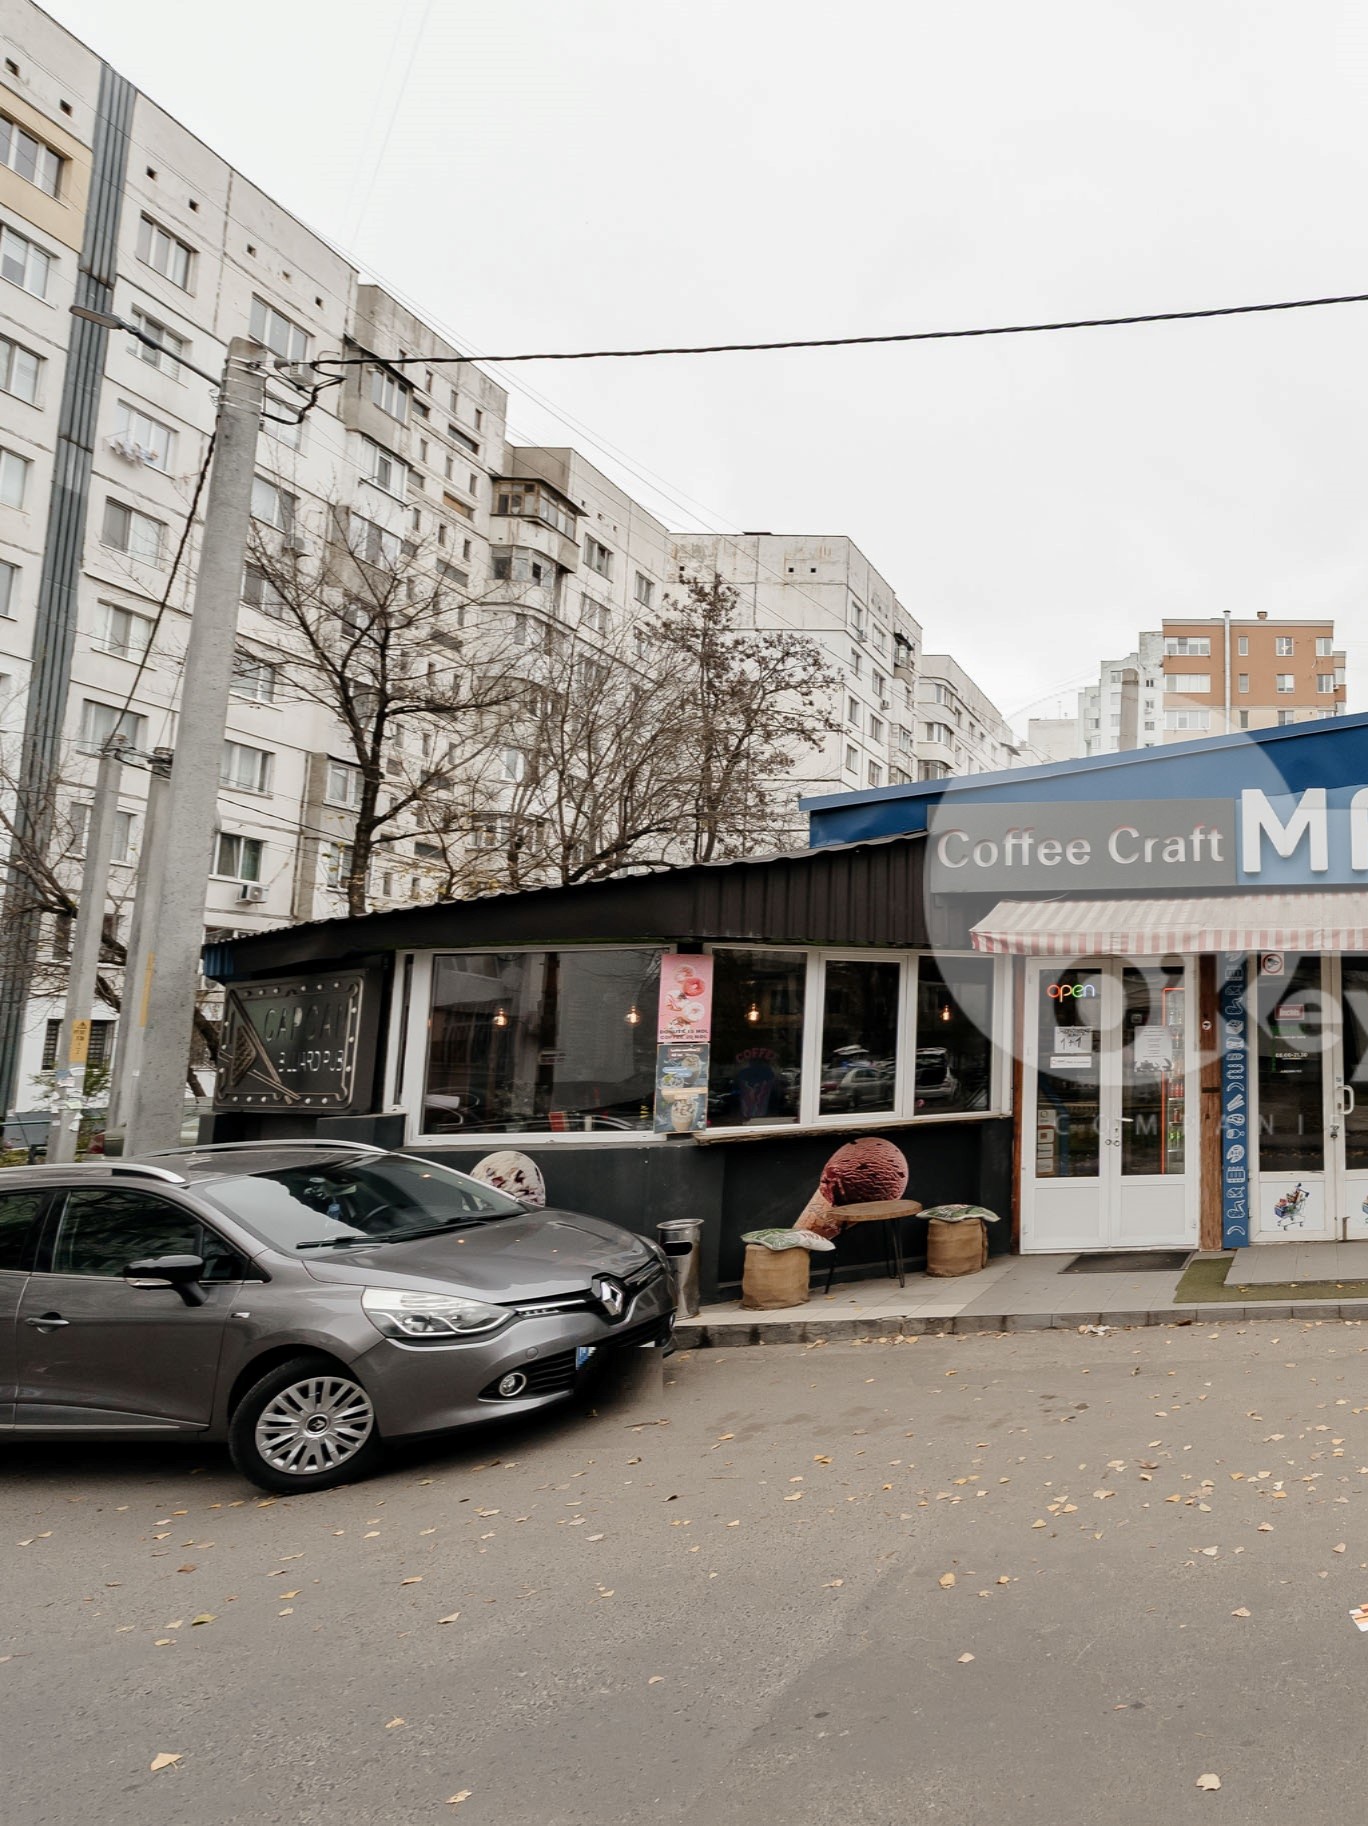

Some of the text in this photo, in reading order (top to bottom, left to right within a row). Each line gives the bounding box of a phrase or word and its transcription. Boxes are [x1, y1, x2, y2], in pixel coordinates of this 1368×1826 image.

[937, 822, 1225, 869] Coffee Craft
[1046, 984, 1095, 1003] open
